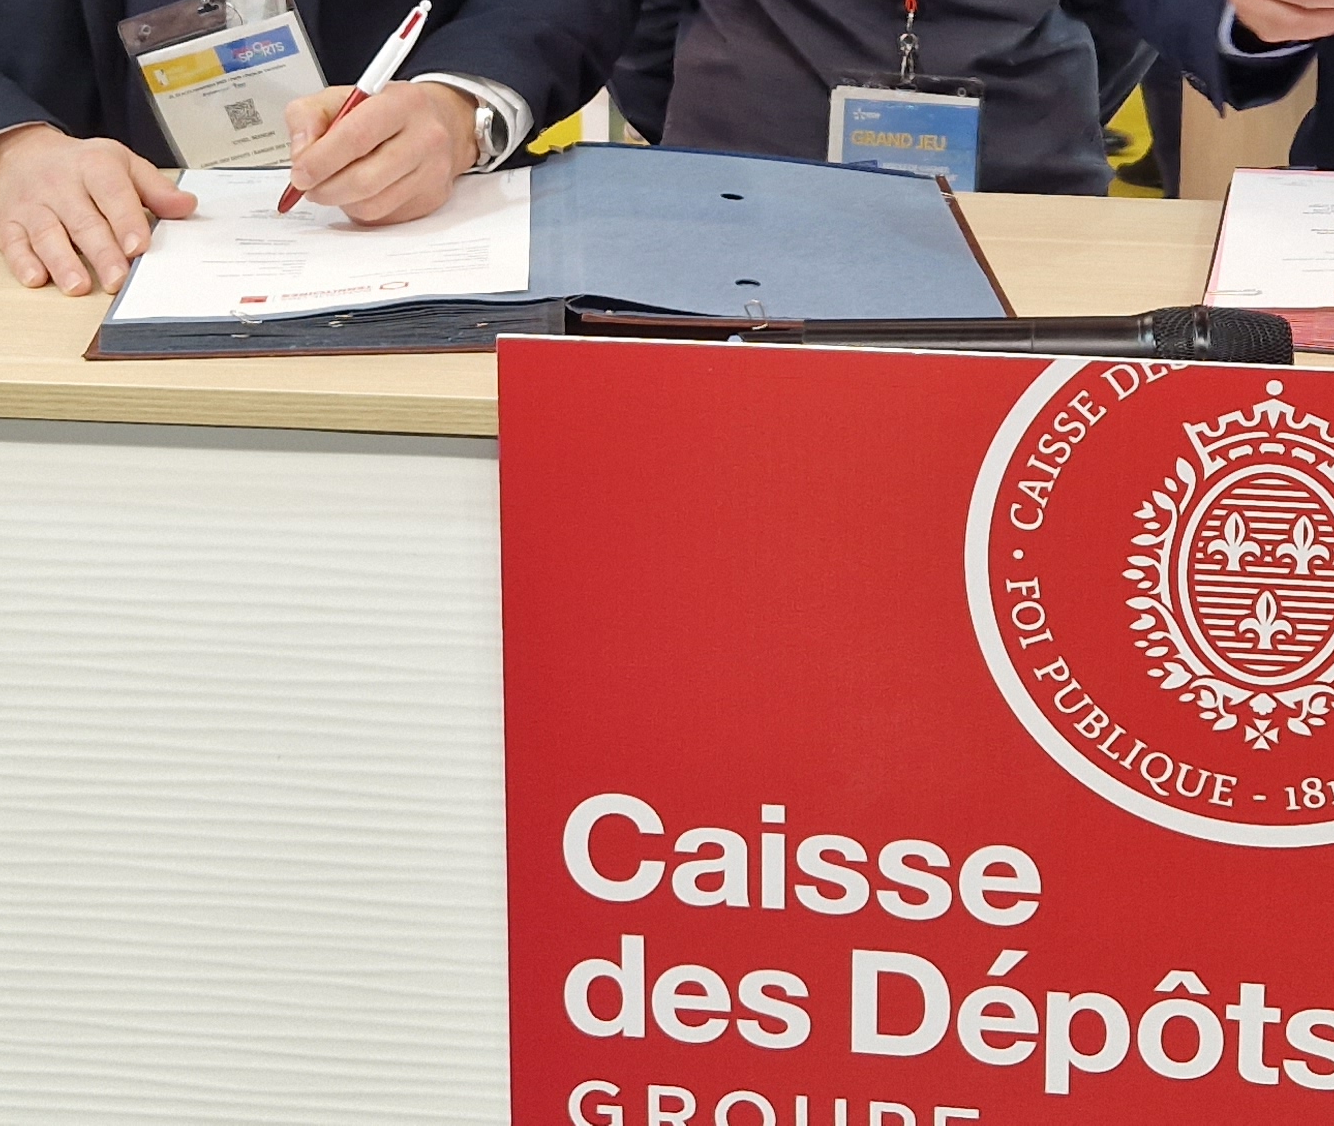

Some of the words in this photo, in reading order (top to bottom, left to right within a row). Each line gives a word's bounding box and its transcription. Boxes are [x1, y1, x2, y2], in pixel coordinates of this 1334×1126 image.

[851, 130, 913, 149] GRAND
[915, 134, 948, 151] JEU
[1010, 390, 1107, 531] CAISSE
[1005, 577, 1054, 649] FOI
[1033, 656, 1238, 808] PUBLIQUE
[562, 793, 1043, 927] Caisse
[563, 934, 812, 1052] des
